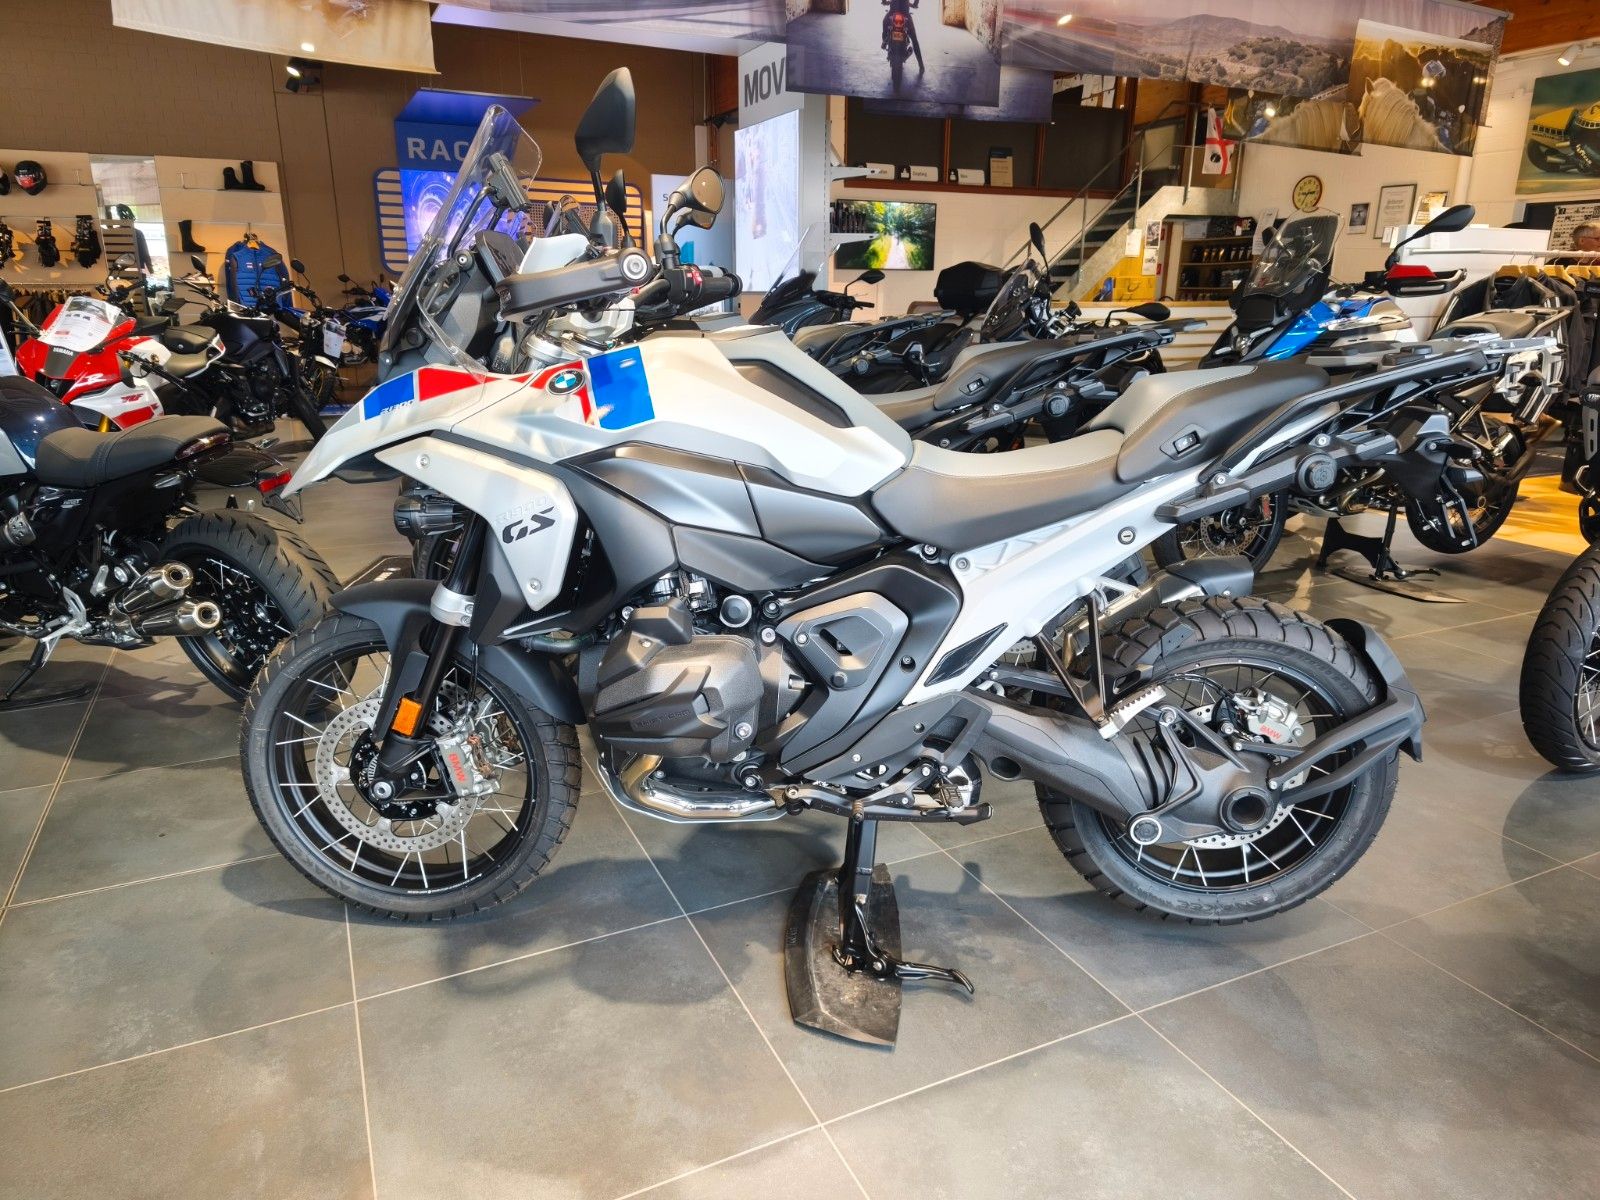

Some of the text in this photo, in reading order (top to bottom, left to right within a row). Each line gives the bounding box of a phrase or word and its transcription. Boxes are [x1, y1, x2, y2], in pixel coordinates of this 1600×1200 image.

[744, 57, 787, 107] MOV
[407, 137, 470, 161] RAC
[502, 506, 556, 544] GS
[1259, 723, 1281, 740] BMW
[448, 752, 466, 782] BMW
